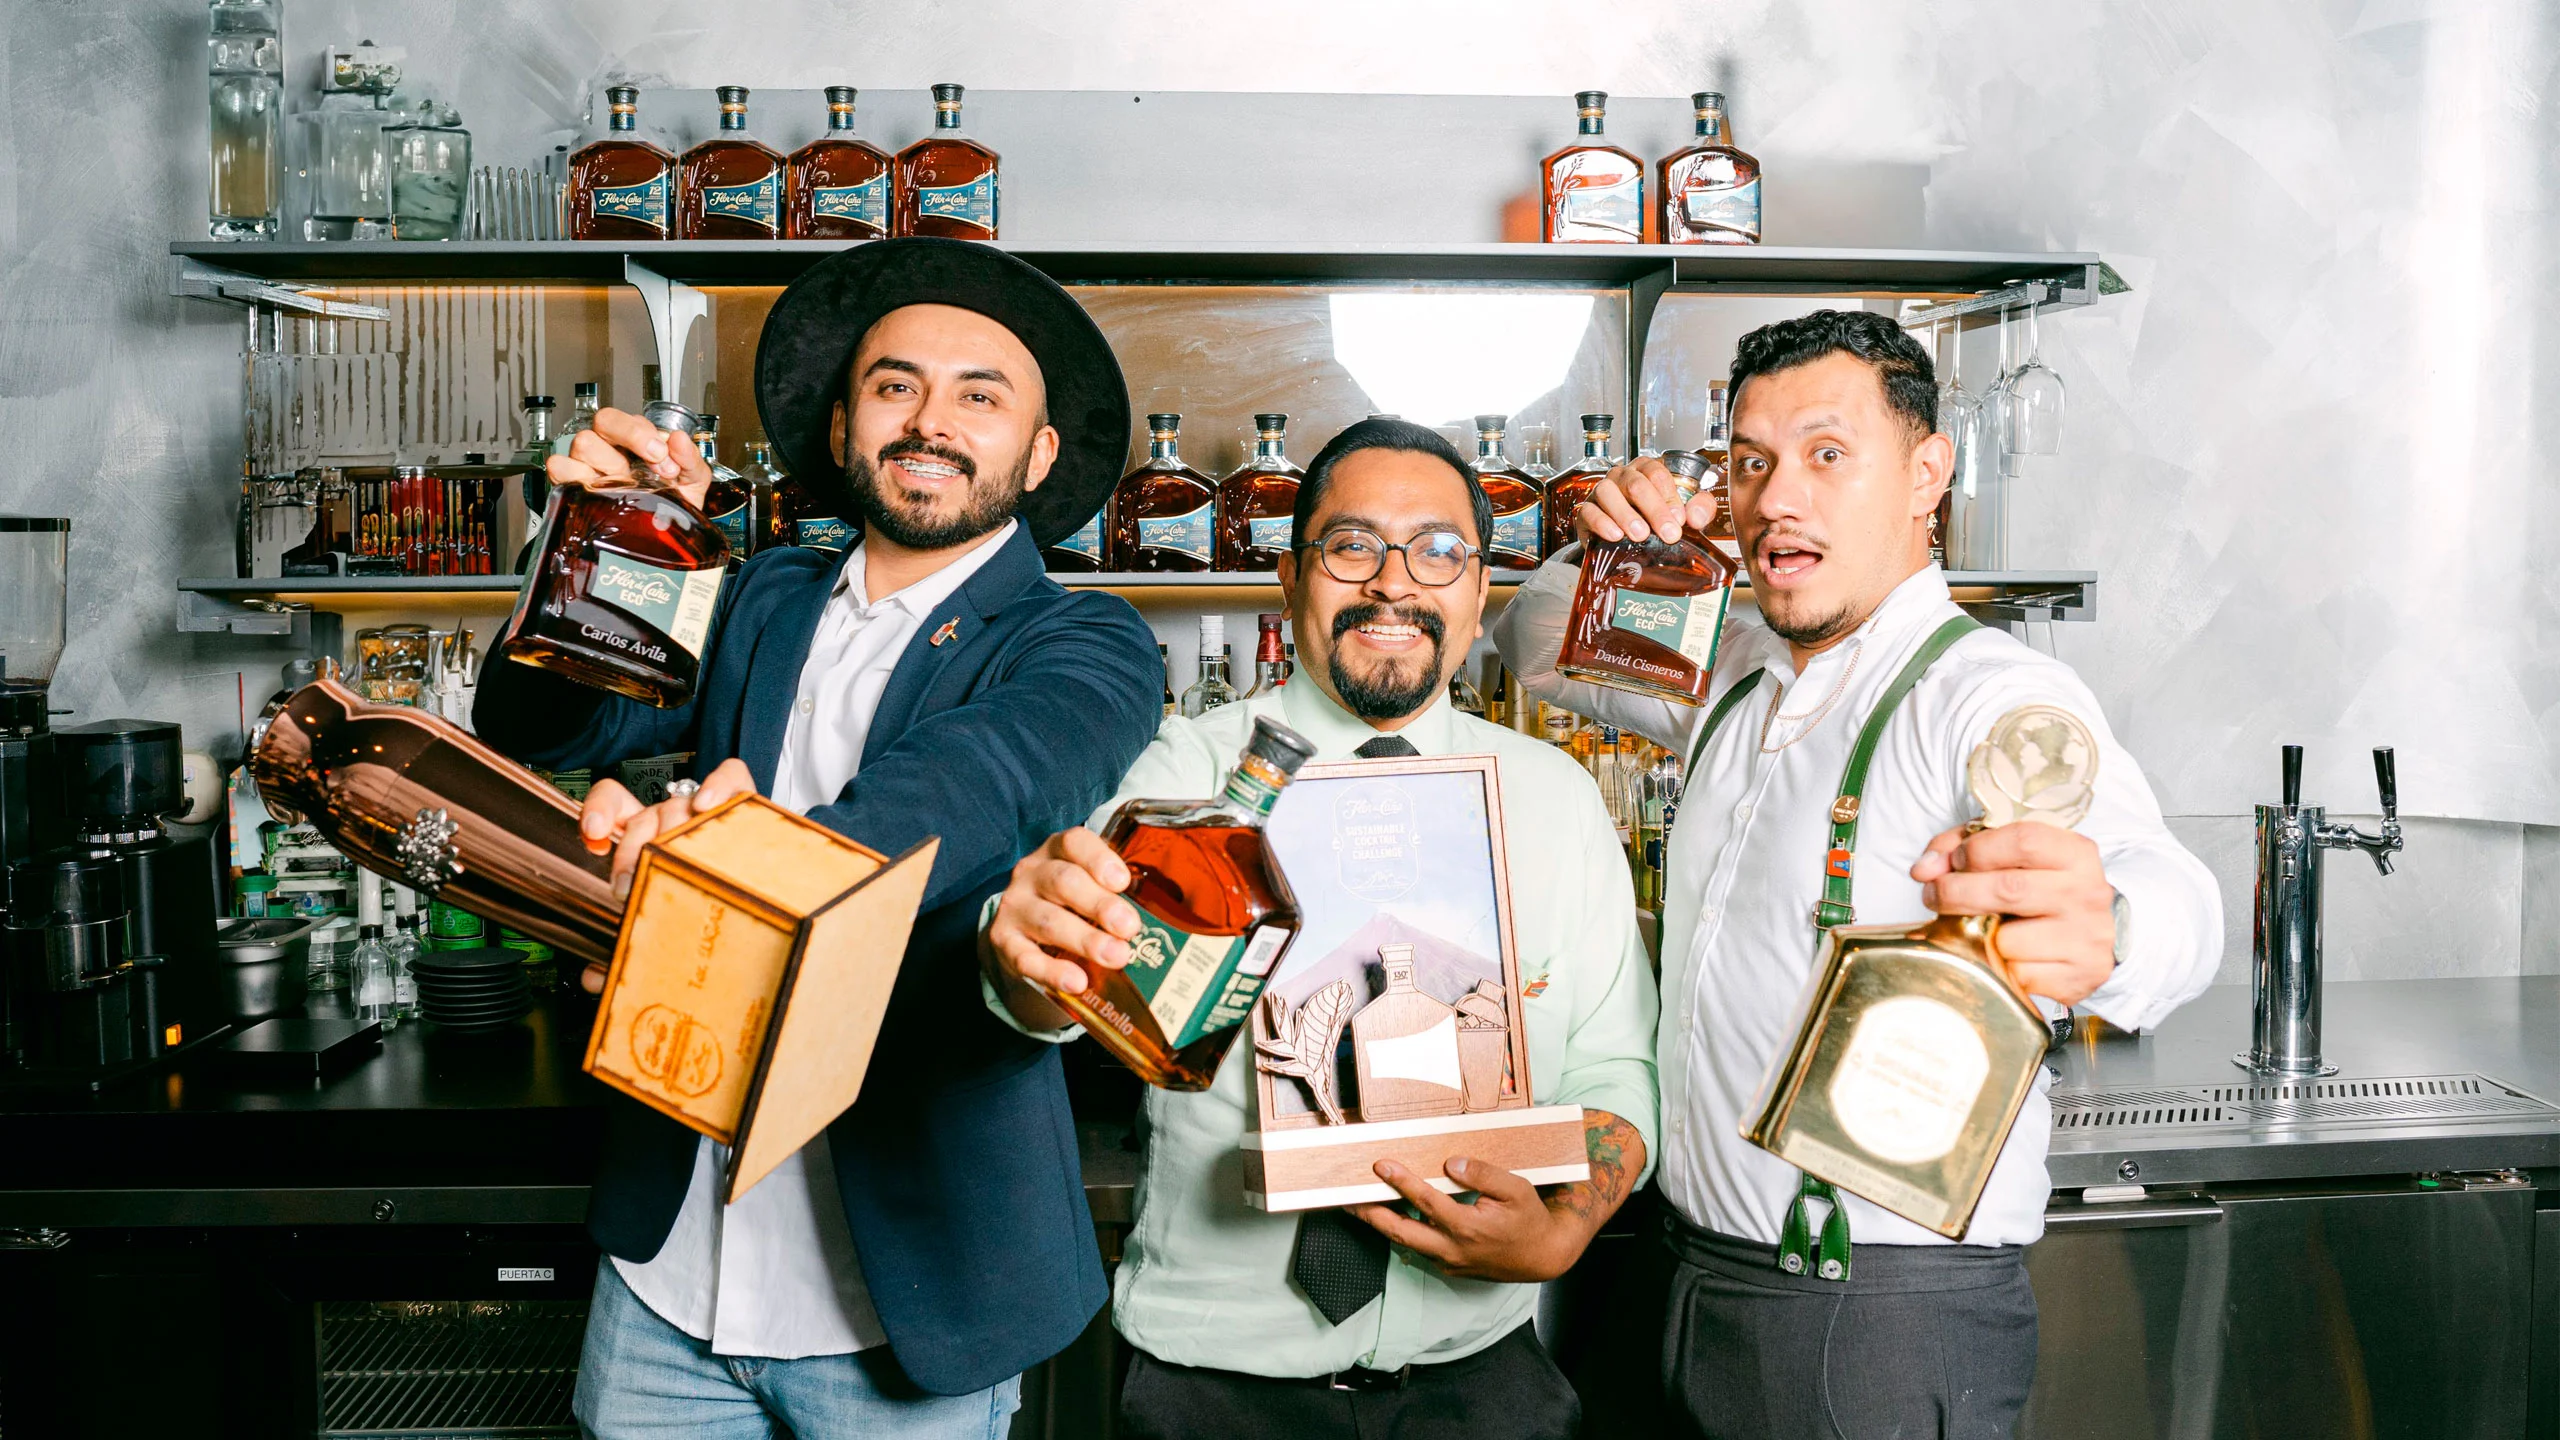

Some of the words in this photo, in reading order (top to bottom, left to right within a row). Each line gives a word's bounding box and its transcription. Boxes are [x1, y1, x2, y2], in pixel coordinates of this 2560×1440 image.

[649, 186, 662, 195] 12
[759, 186, 772, 195] 12
[868, 187, 881, 196] 12
[974, 186, 987, 195] 12
[729, 518, 742, 527] 12
[802, 524, 823, 538] Flor
[828, 524, 846, 538] Caña
[599, 565, 635, 589] Flor
[642, 581, 671, 604] Caña
[619, 589, 644, 606] ECO
[1618, 600, 1646, 618] Flor
[1645, 609, 1655, 617] de
[1653, 608, 1678, 627] Caña
[1635, 618, 1655, 631] ECO
[581, 623, 629, 649] Carlos
[628, 640, 667, 663] Avila
[1593, 648, 1632, 667] David
[1632, 658, 1685, 680] Cisneros
[1345, 823, 1406, 836] SUSTAINABLE
[1354, 834, 1398, 846] COCKTAIL
[1352, 846, 1403, 860] CHALLENGE
[1136, 937, 1166, 970] Caña
[500, 1269, 541, 1279] PUERTA
[543, 1269, 551, 1279] C
